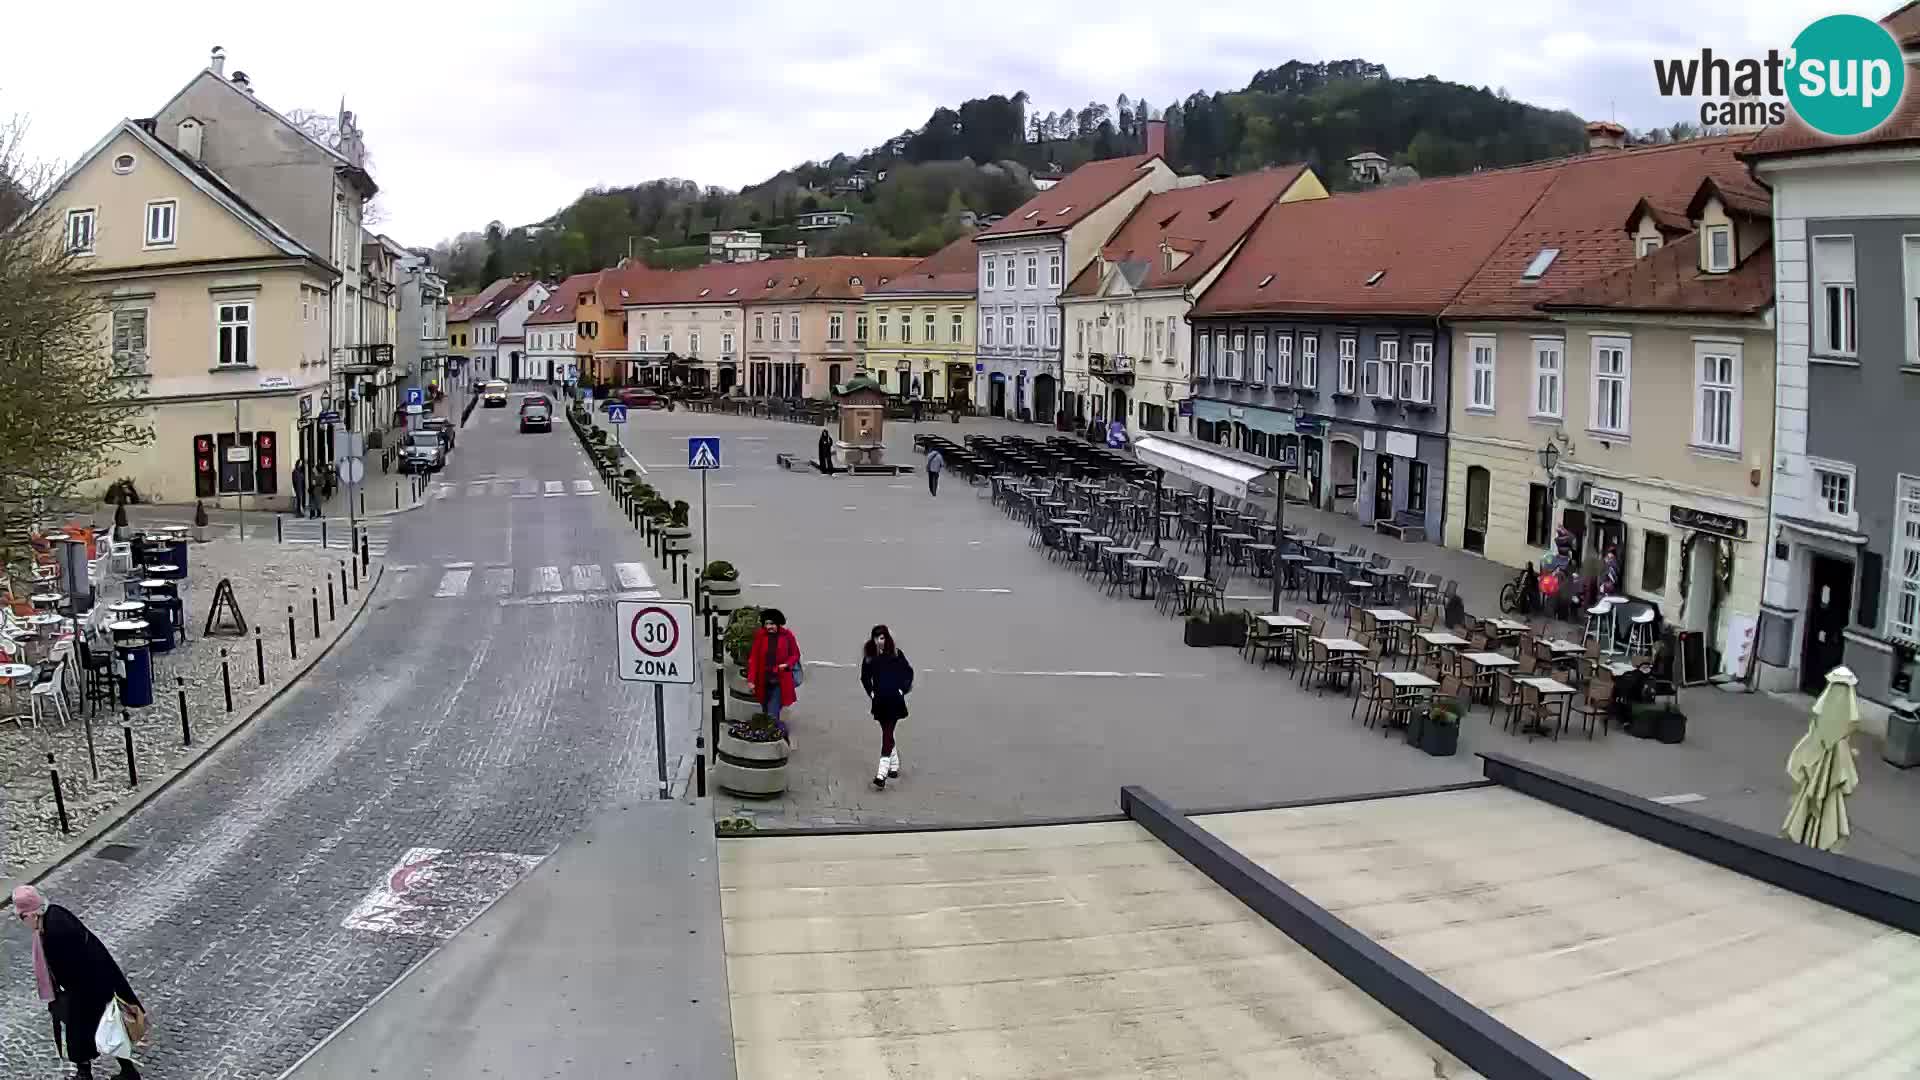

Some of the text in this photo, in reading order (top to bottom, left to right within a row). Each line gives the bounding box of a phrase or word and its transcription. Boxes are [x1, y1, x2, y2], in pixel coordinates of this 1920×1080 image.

[411, 392, 418, 403] P
[644, 622, 667, 643] 30
[634, 660, 678, 676] ZONA
